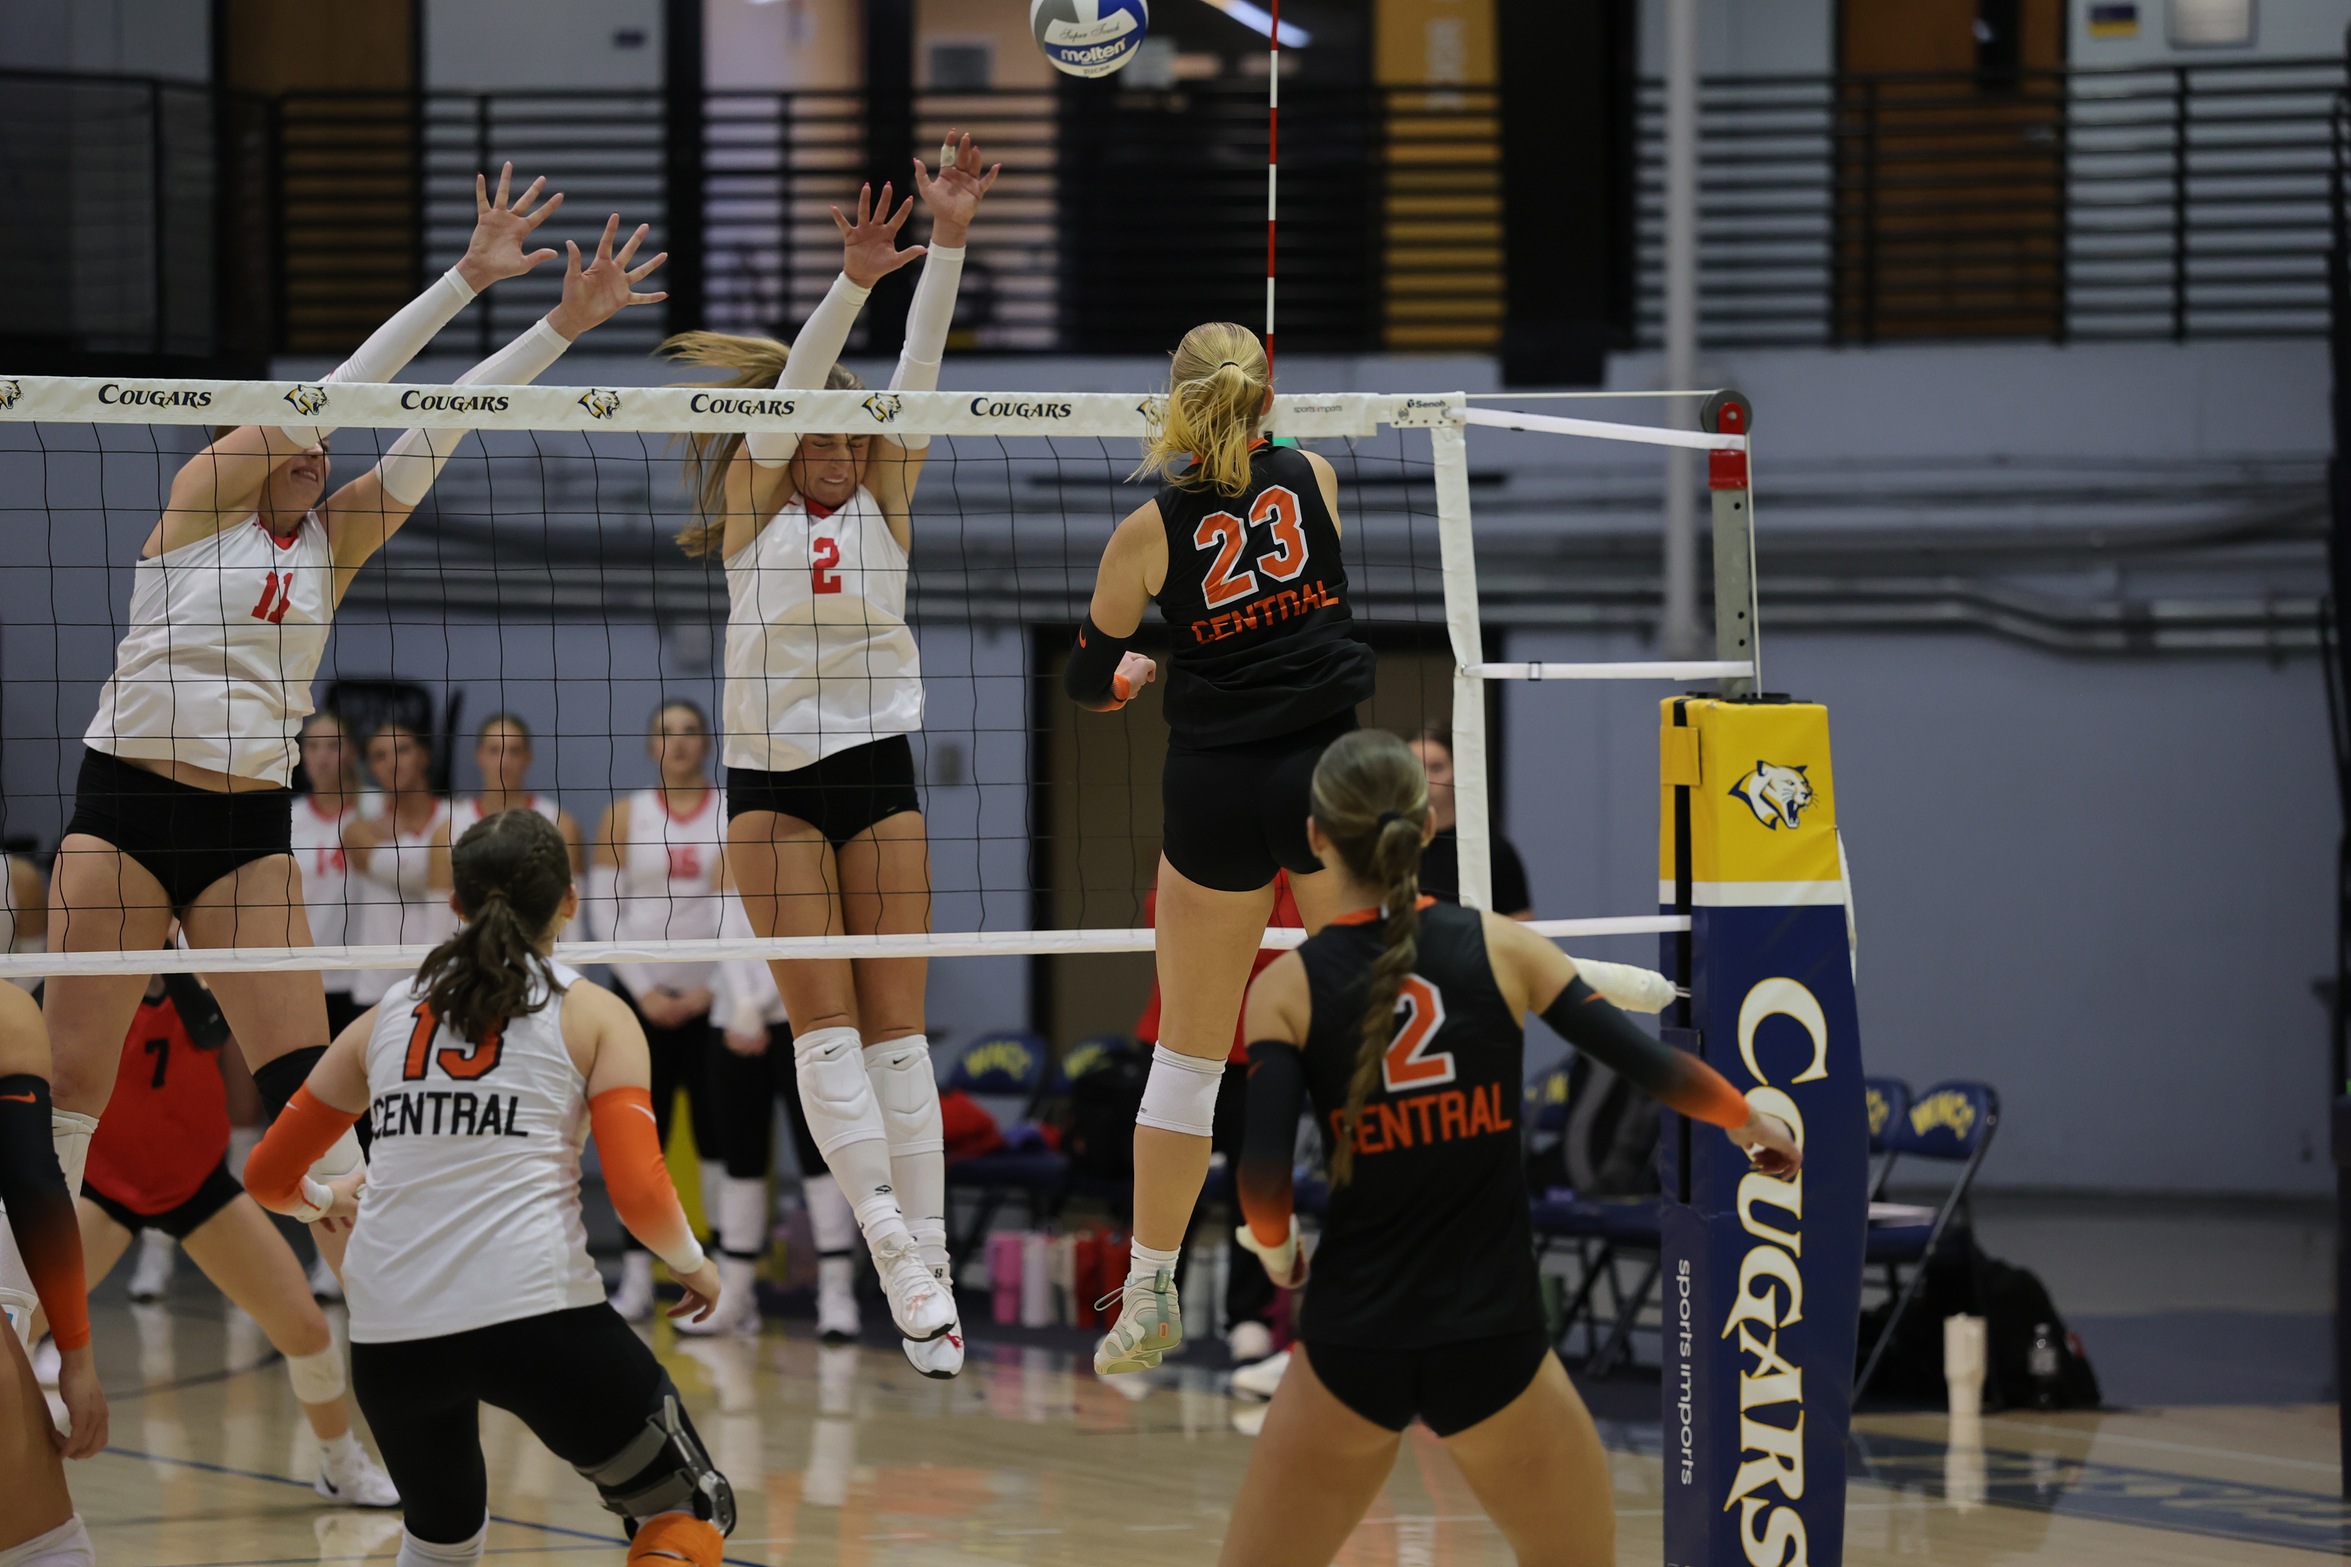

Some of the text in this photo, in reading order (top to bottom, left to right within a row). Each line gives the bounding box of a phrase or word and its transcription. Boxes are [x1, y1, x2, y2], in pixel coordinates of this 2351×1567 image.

[1061, 38, 1126, 62] molten
[98, 384, 212, 409] COUGARS
[401, 390, 509, 413] COUGARS
[690, 394, 795, 417] COUGARS
[970, 397, 1071, 420] COUGARS
[1416, 400, 1446, 408] Senoh
[813, 537, 841, 594] 2
[1193, 485, 1309, 610] 23
[251, 571, 293, 624] 11
[1191, 581, 1339, 644] CENTRAL
[1382, 973, 1456, 1093] 2
[144, 1037, 169, 1088] 7
[372, 1091, 528, 1140] CENTRAL
[1676, 1259, 1694, 1485] sports imports
